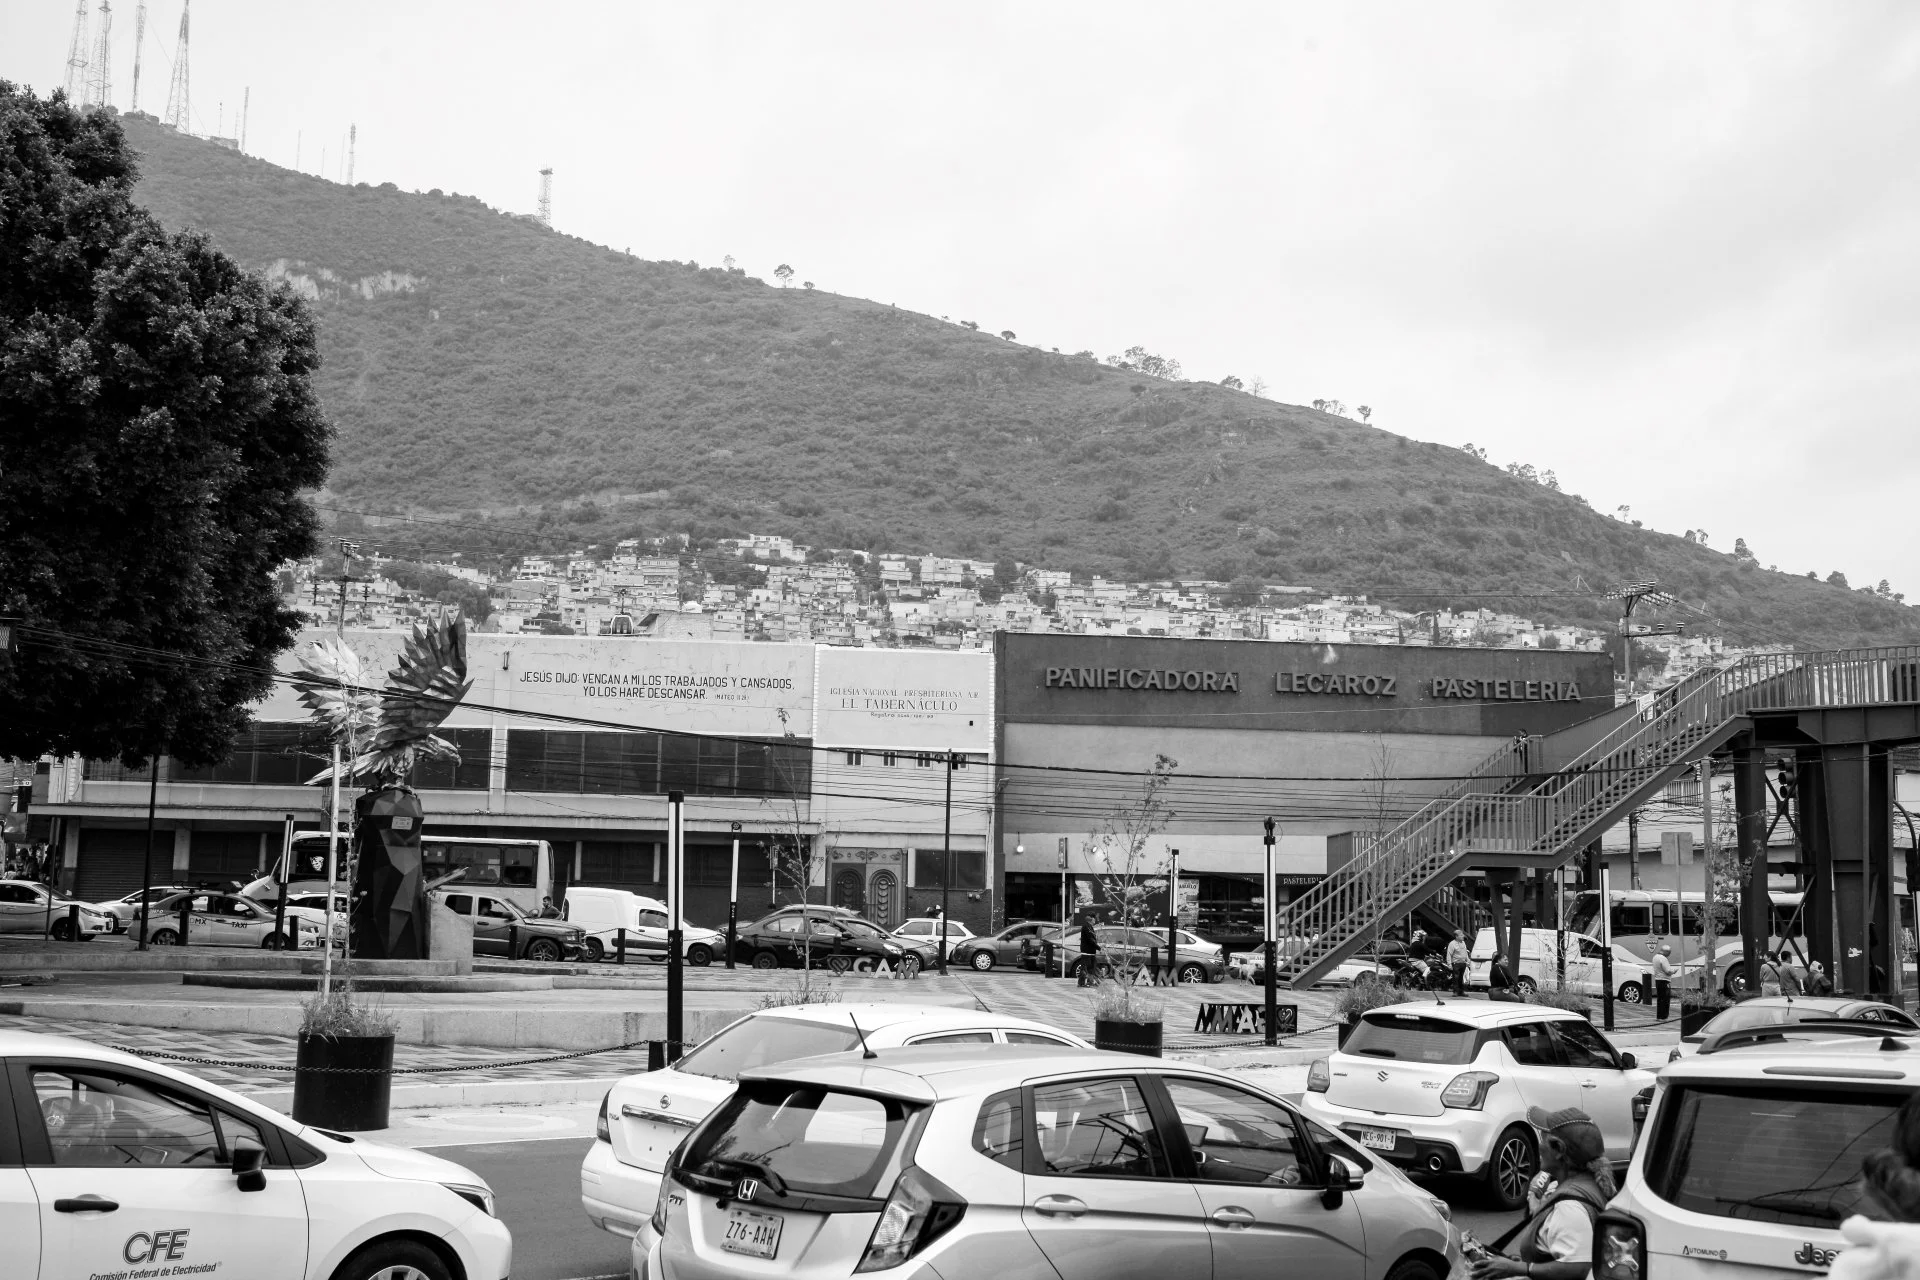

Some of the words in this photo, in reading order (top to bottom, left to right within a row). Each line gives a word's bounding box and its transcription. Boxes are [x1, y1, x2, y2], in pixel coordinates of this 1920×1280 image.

[520, 670, 552, 683] JESÚS
[555, 672, 580, 684] DIJO:
[582, 673, 621, 685] VENGAN
[623, 674, 628, 685] A
[642, 675, 662, 686] LOS
[664, 675, 728, 688] TRABAJADOS
[731, 677, 737, 688] Y
[1045, 667, 1239, 692] PANIFICADORA
[1275, 671, 1397, 696] LECAROZ
[1431, 678, 1582, 701] PASTELERIA
[583, 686, 596, 697] YO
[598, 686, 617, 698] LOS
[620, 685, 645, 698] HARÉ
[830, 687, 860, 696] IGLESIA
[862, 688, 898, 697] NACIONAL
[904, 689, 963, 698] PRESBITERIANA
[841, 698, 859, 709] EL
[864, 698, 958, 711] TABERNÁCULO
[853, 957, 920, 980] GAM
[122, 1228, 191, 1265] CFE
[1794, 1242, 1841, 1267] Jee
[128, 1267, 160, 1280] Federal
[161, 1266, 171, 1277] de
[172, 1263, 217, 1276] Electricidad
